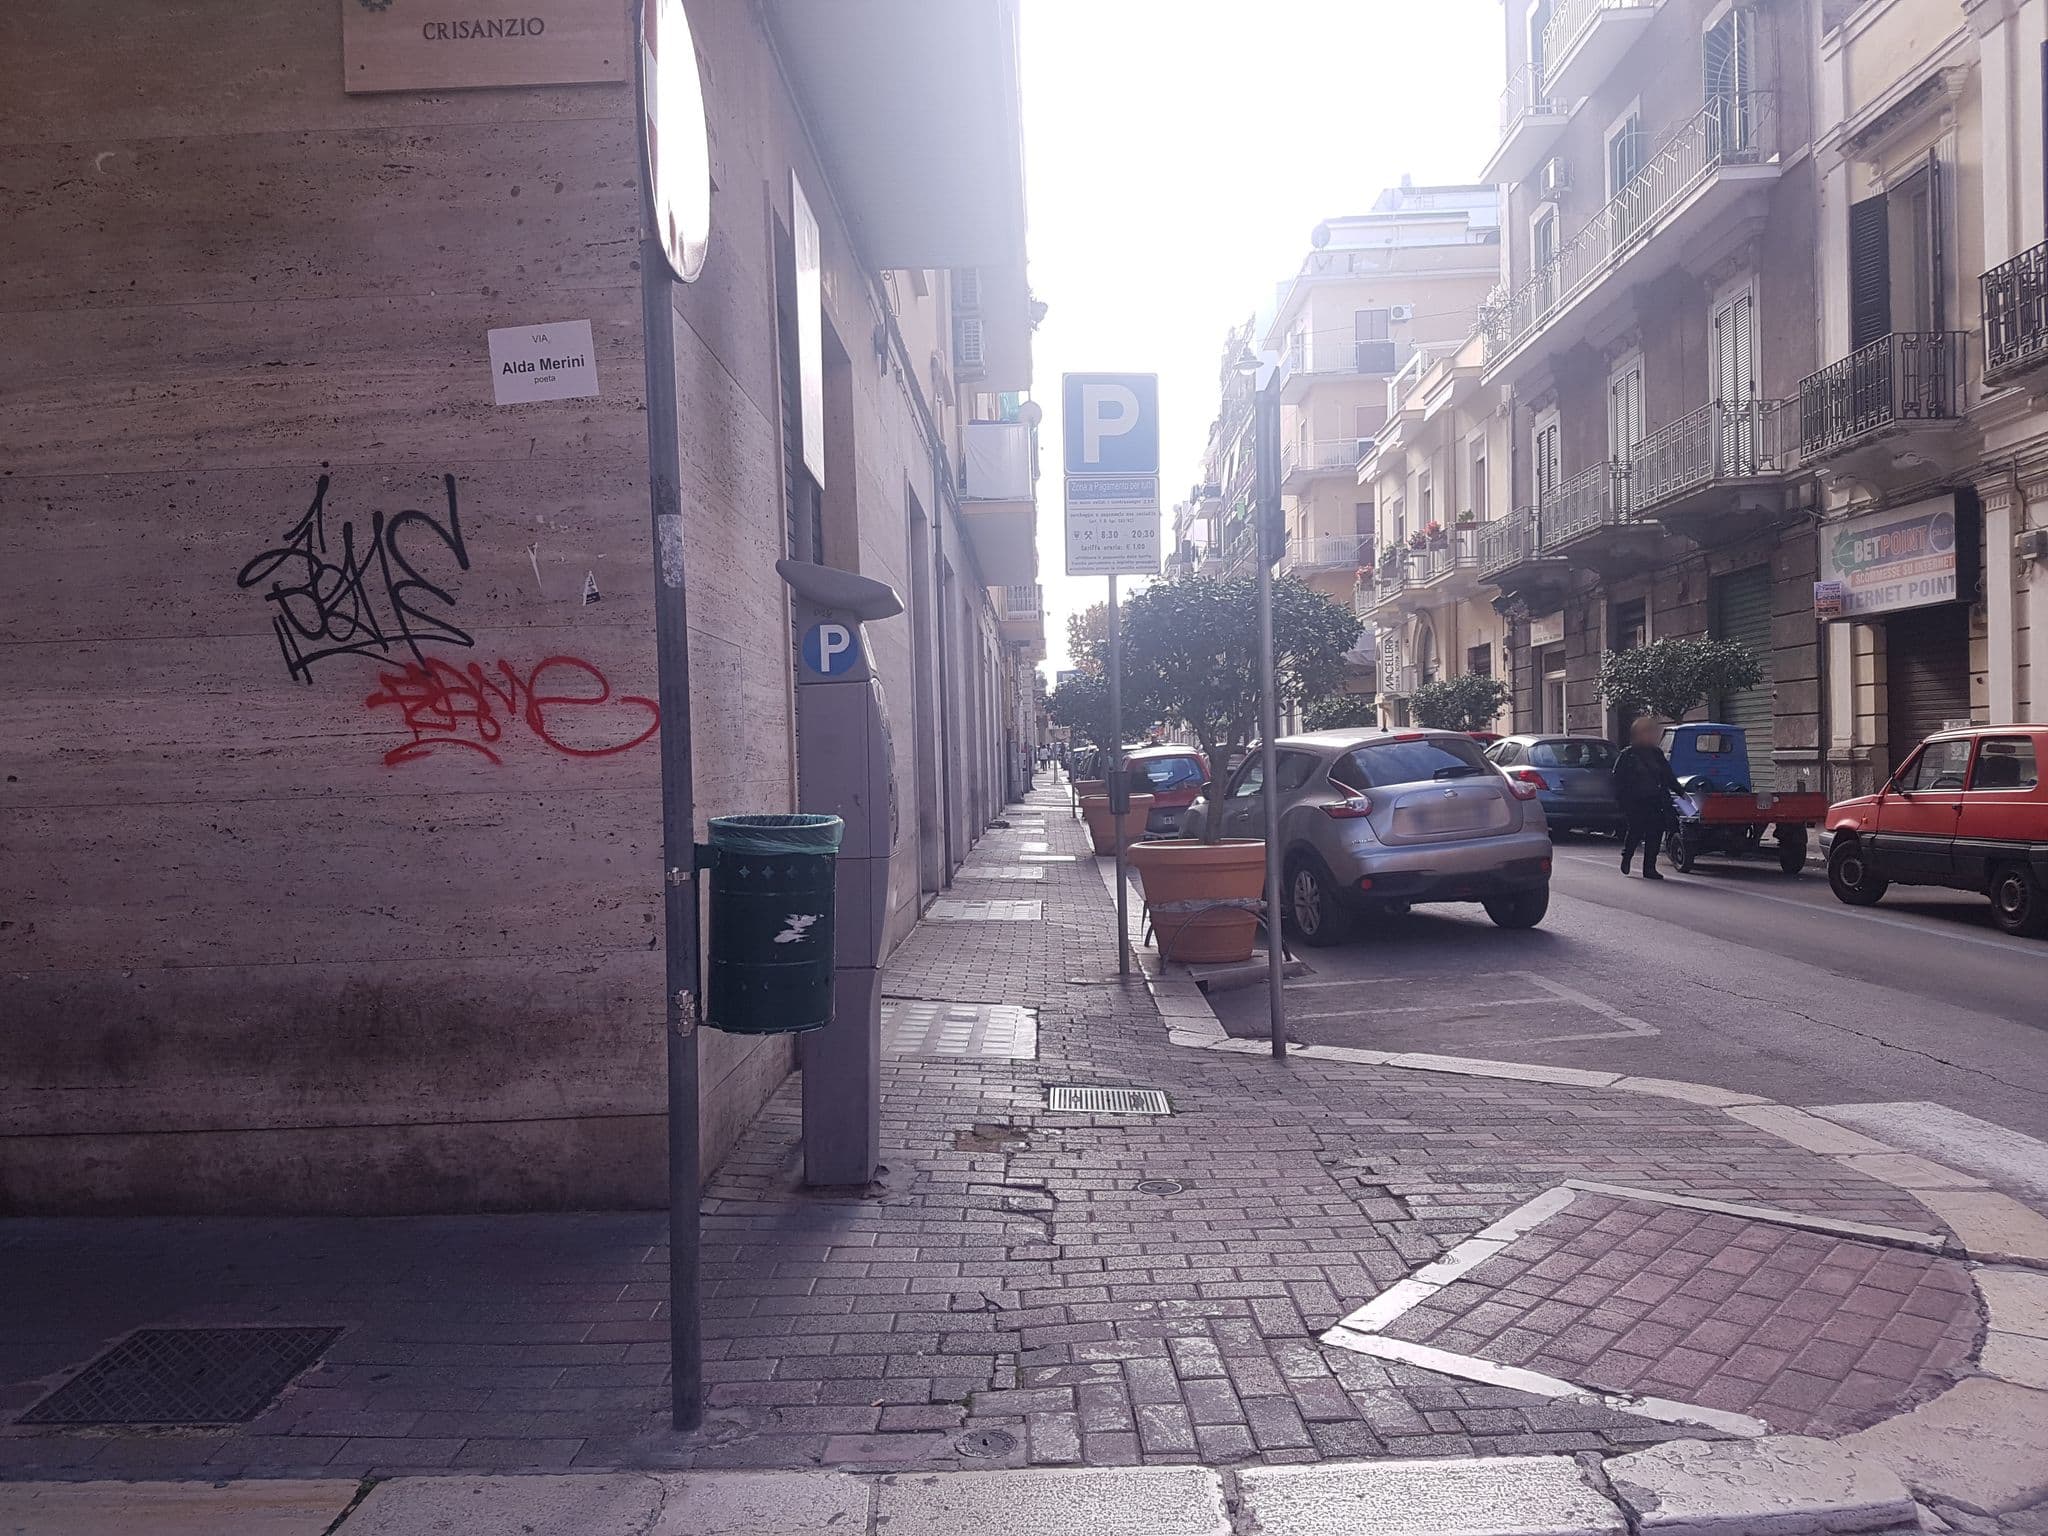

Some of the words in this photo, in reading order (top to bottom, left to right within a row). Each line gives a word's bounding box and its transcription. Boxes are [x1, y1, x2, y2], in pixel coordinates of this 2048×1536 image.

[423, 17, 545, 40] CRISANZIO
[531, 334, 549, 344] VIA
[502, 360, 535, 375] Alda
[540, 354, 585, 371] Merini
[534, 374, 556, 385] poeta
[1083, 384, 1140, 464] P
[1855, 569, 1901, 585] SCOMMESSE
[1903, 564, 1913, 575] SU
[1914, 556, 1954, 573] INTERNET
[1908, 575, 1956, 601] POINT
[819, 624, 850, 672] P
[1384, 635, 1394, 690] MACELLERIA
